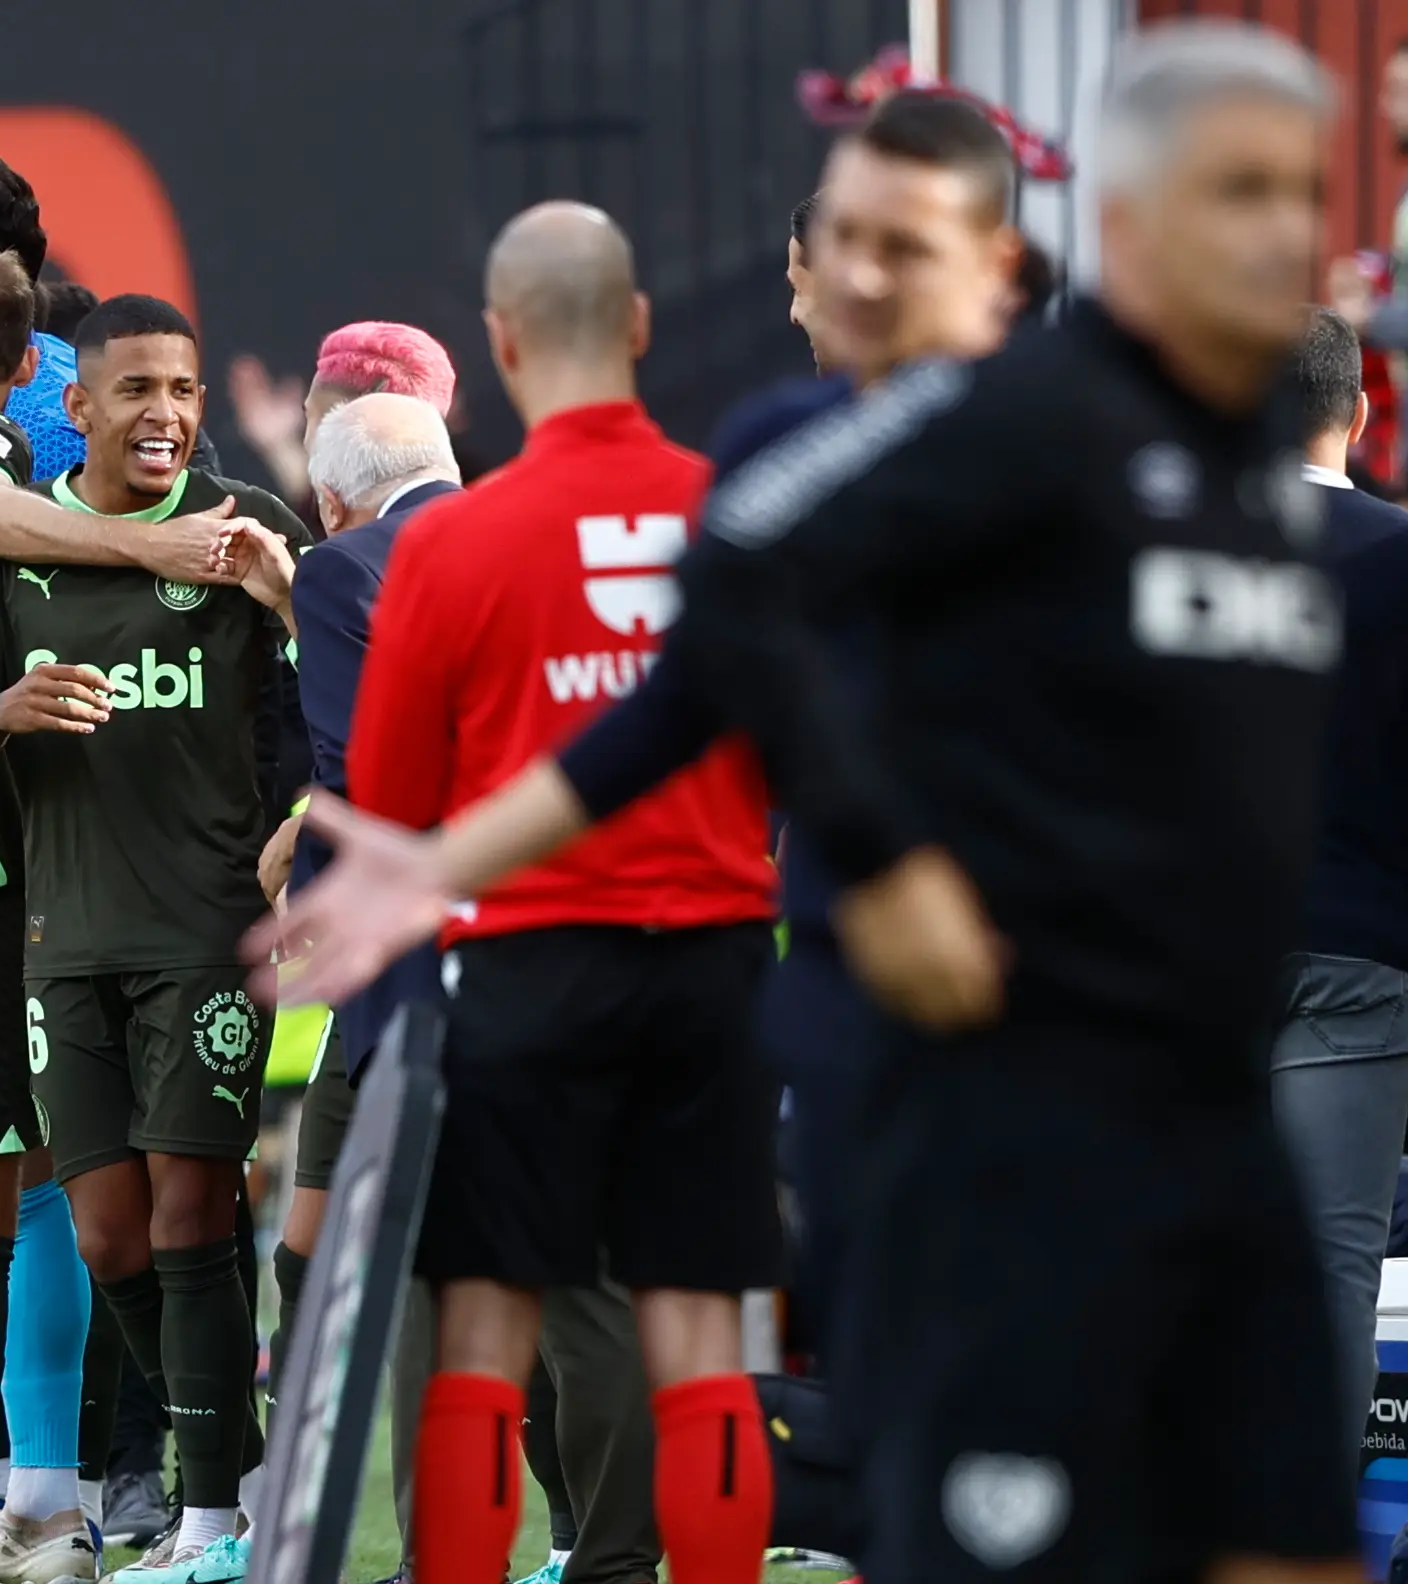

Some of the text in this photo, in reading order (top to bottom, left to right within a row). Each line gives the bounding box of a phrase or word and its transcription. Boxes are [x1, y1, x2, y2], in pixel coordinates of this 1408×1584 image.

[193, 992, 232, 1024] Costa
[220, 1022, 245, 1048] G!
[192, 1030, 221, 1072] Pirineu
[222, 1063, 237, 1075] de
